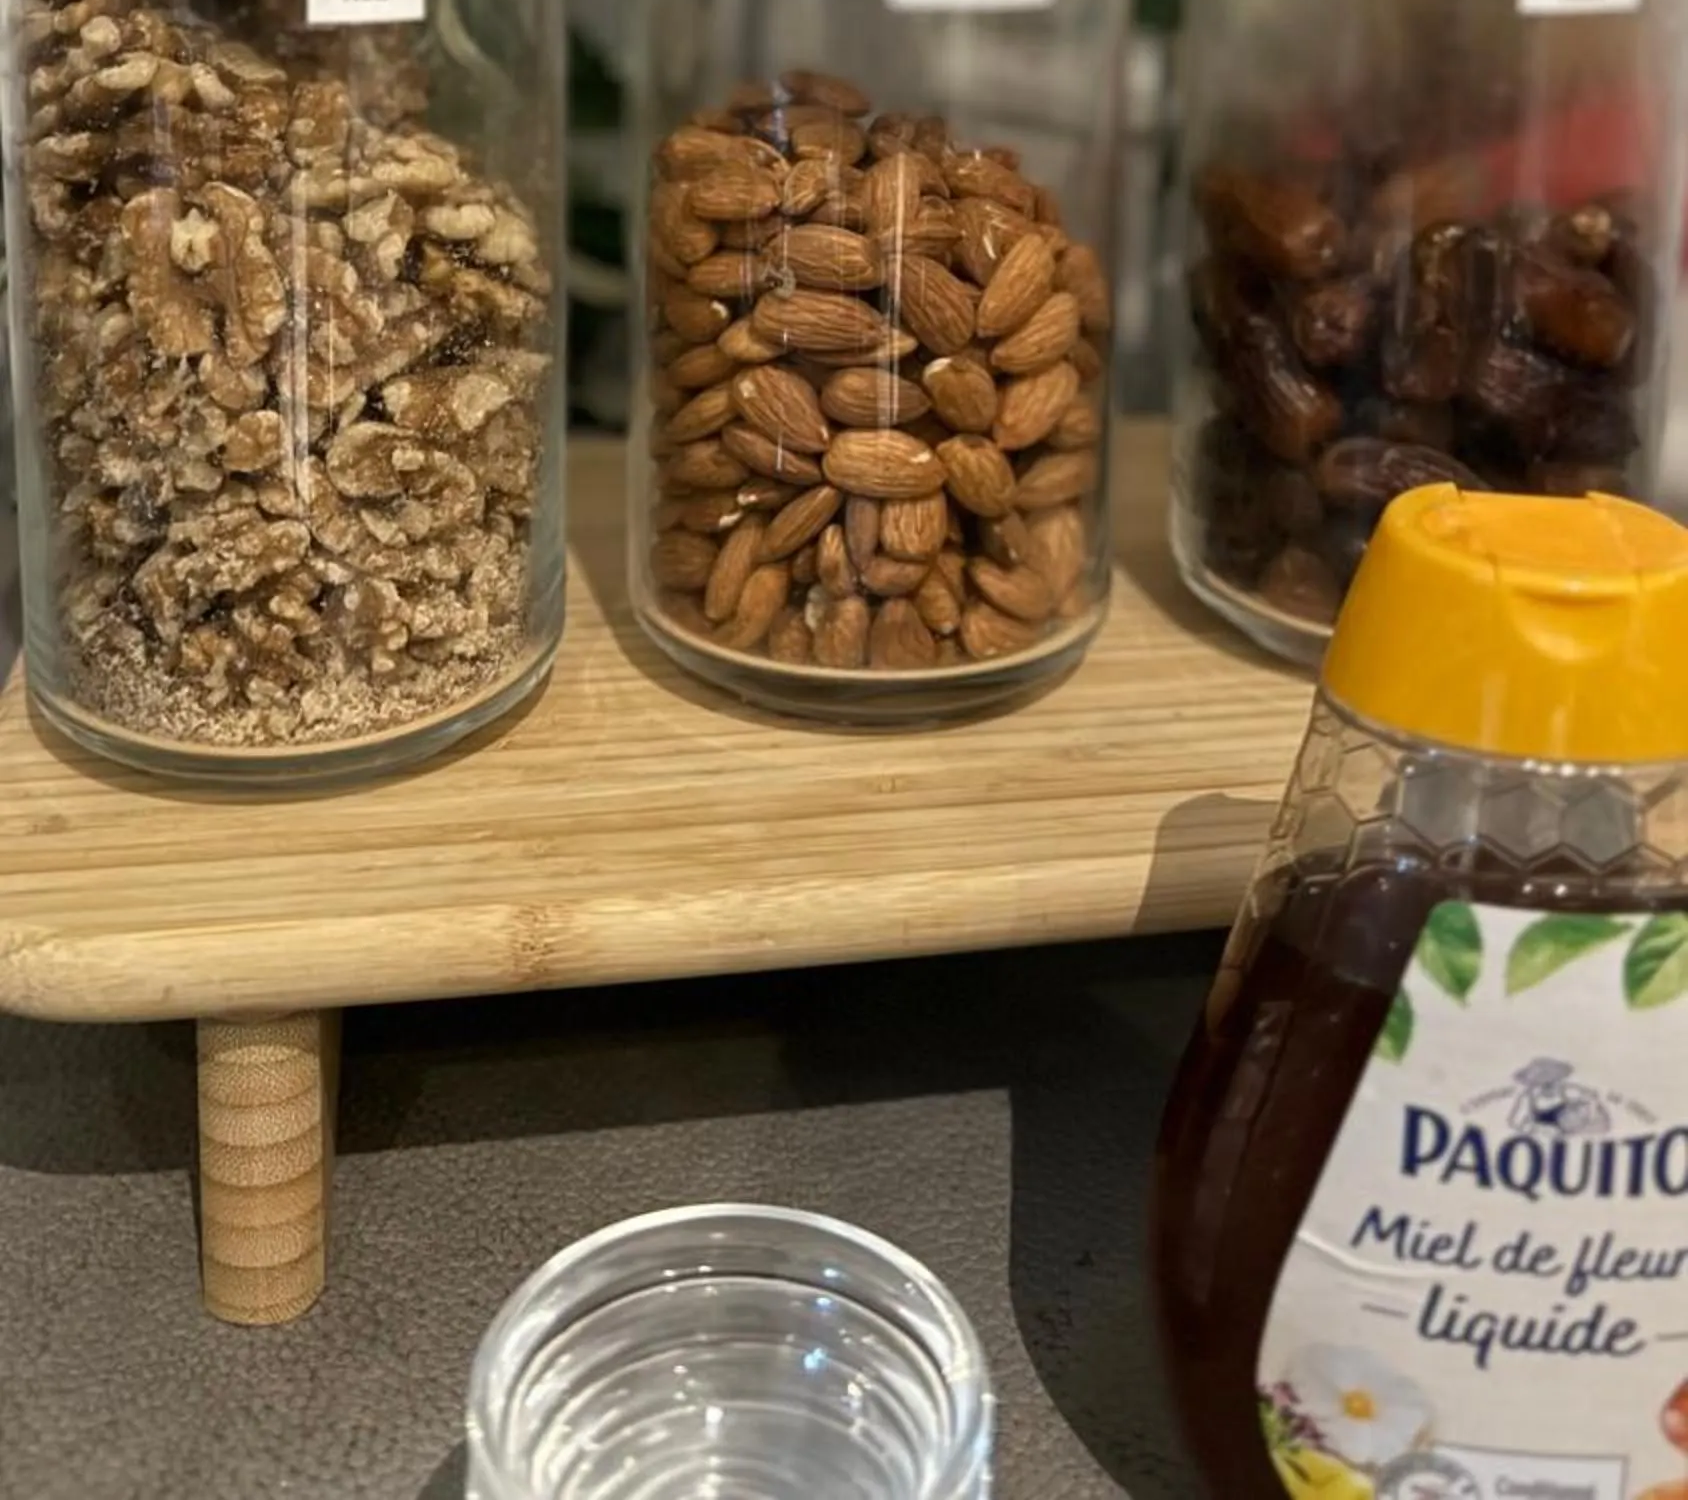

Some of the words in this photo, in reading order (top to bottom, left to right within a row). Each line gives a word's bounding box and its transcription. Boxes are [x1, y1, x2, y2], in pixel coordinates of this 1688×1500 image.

[1401, 1103, 1688, 1202] PAQUITO
[1350, 1205, 1482, 1270] Miel
[1492, 1232, 1565, 1276] de
[1417, 1284, 1646, 1370] liquide
